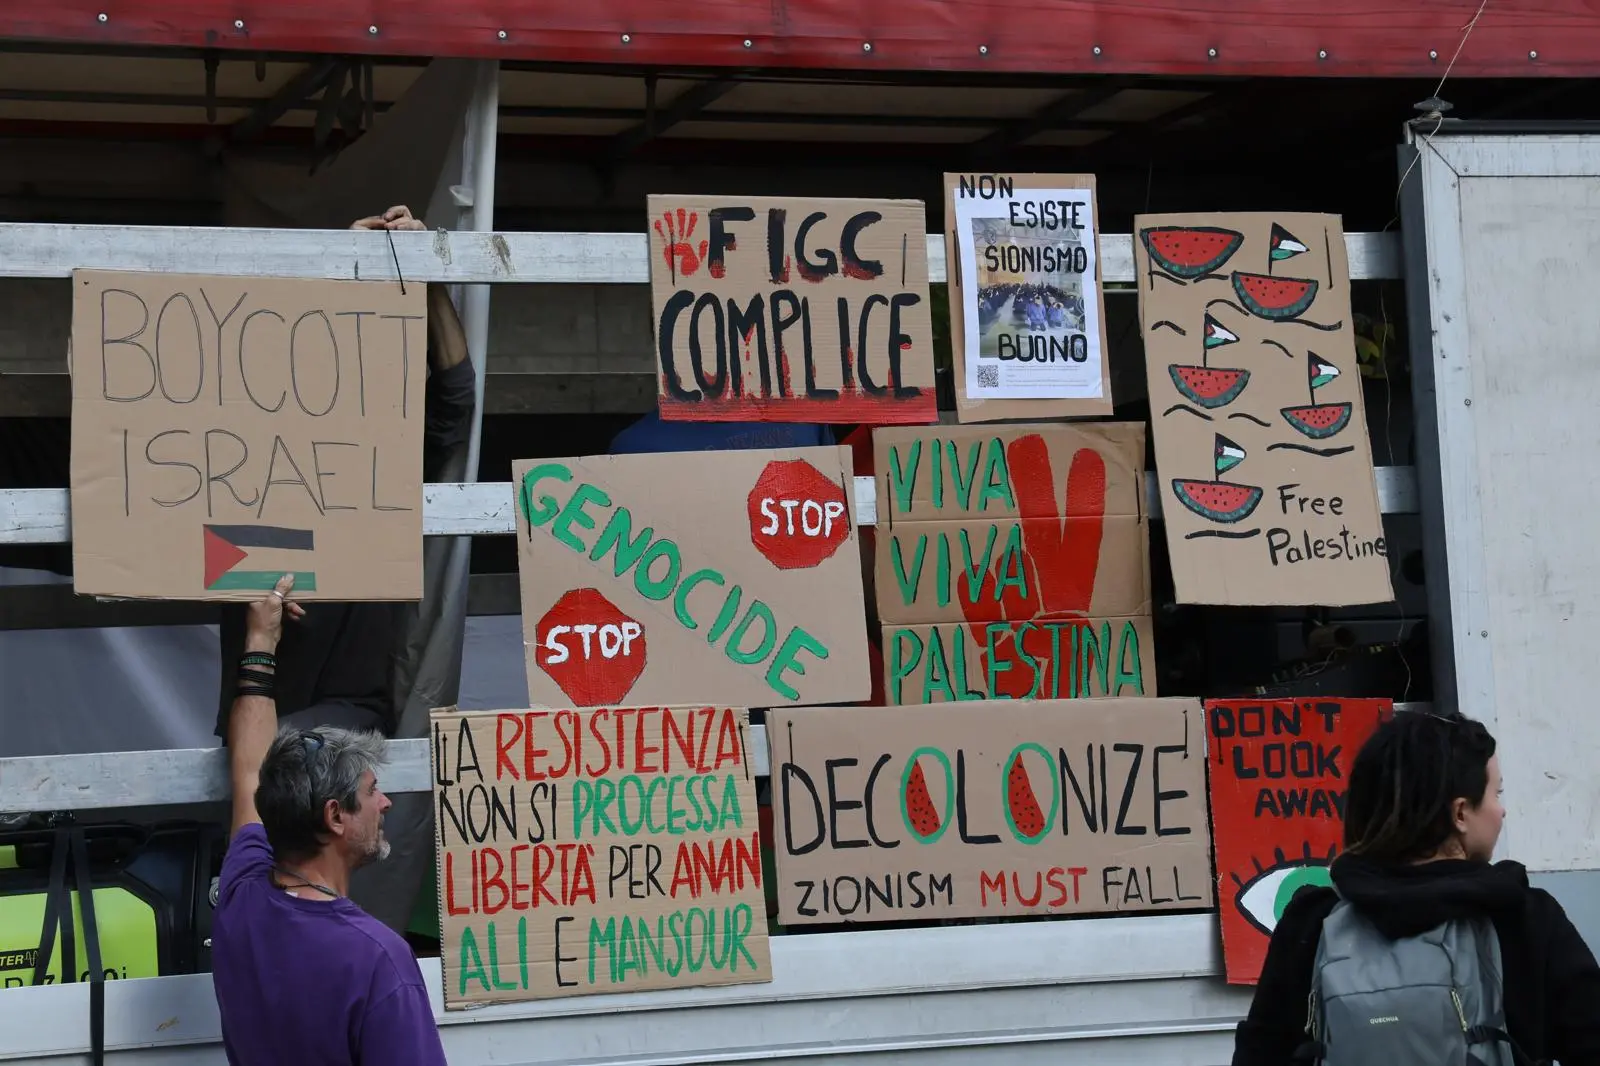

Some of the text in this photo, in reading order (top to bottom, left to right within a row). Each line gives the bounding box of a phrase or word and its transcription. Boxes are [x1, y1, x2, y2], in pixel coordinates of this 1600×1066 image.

[960, 175, 1013, 199] NON
[1009, 201, 1086, 230] ESISTE
[708, 206, 885, 284] FIGC
[984, 245, 1088, 273] SIONISMO
[101, 288, 424, 418] BOYCOTT
[659, 290, 921, 402] COMPLICE
[998, 333, 1088, 363] BUONO
[124, 429, 413, 519] ISRAEL
[889, 437, 1015, 512] VIVA
[1277, 484, 1344, 515] Free
[760, 497, 844, 538] STOP
[1266, 524, 1387, 565] Palestine
[519, 463, 829, 701] GENOCIDE
[891, 524, 1028, 608] VIVA
[545, 621, 642, 665] STOP
[891, 621, 1144, 705] PALESTINA
[435, 707, 741, 786] LA RESISTENZA
[1209, 702, 1341, 738] DON'T
[1232, 741, 1343, 779] LOOK
[439, 774, 743, 846] NON SI PROCESSA
[782, 742, 1192, 855] DECOLONIZE
[608, 844, 666, 899] PER
[669, 831, 761, 899] ANAN
[794, 866, 1203, 916] ZIONISM MUST FALL
[459, 902, 758, 997] ALI E MANSOUR
[1369, 1015, 1399, 1025] QUECHUA
